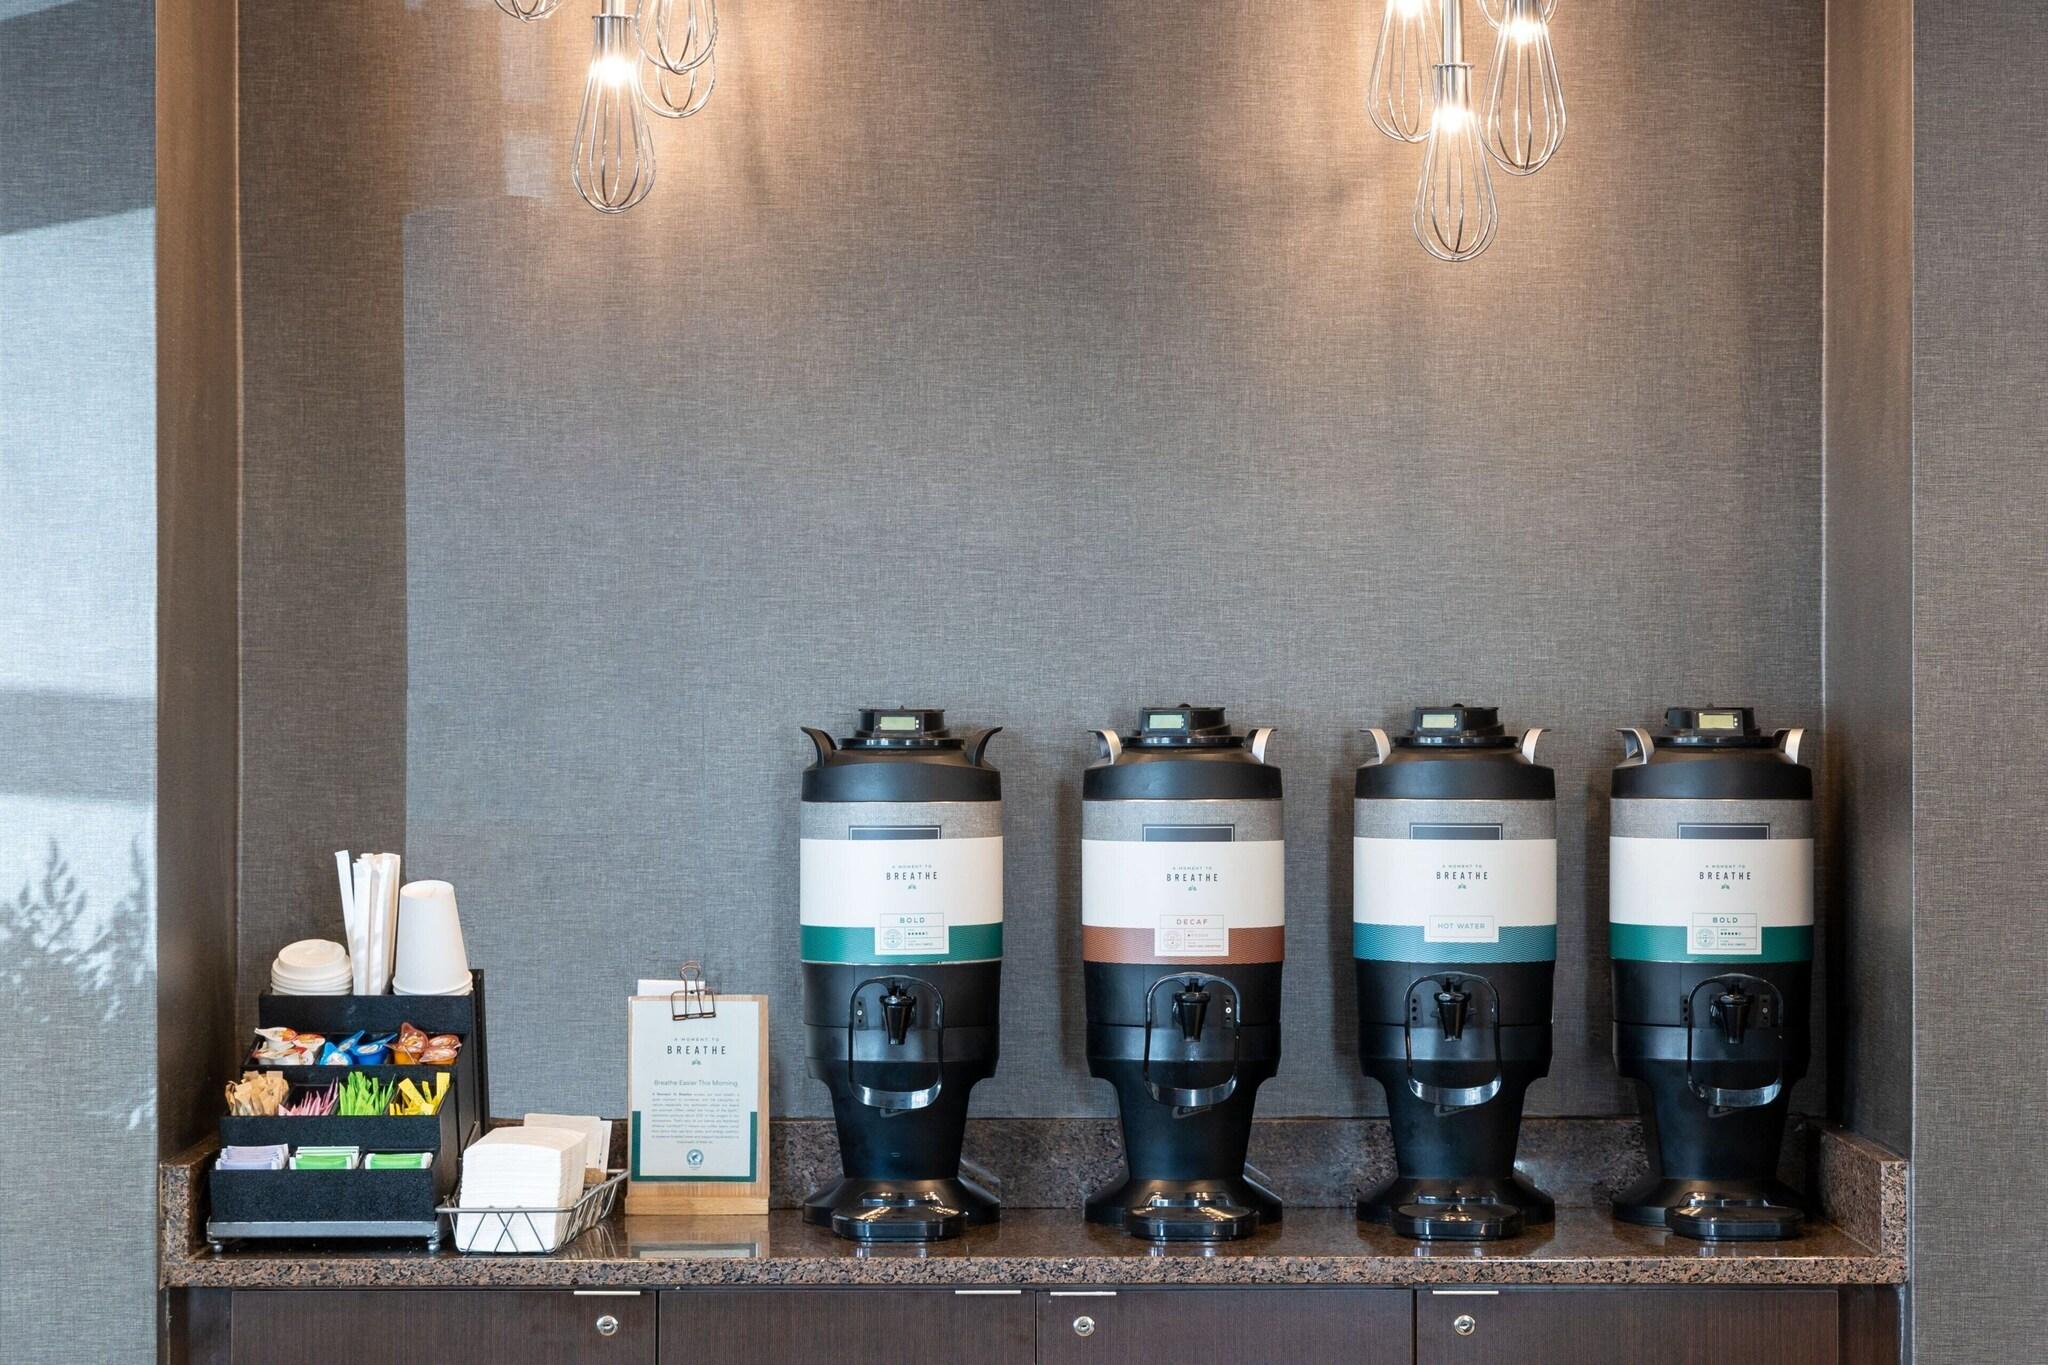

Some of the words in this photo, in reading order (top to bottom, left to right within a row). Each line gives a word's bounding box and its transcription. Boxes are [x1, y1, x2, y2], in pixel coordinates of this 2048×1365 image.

[886, 871, 938, 881] BREATHE
[1166, 873, 1219, 882] BREATHE
[1436, 871, 1489, 880] BREATHE
[1699, 871, 1752, 880] BREATHE
[1176, 918, 1209, 926] DECAF
[666, 1045, 727, 1055] BREATHE
[654, 1079, 677, 1087] Breathe
[679, 1079, 697, 1087] Easier
[698, 1079, 711, 1087] This
[712, 1079, 738, 1088] Morning
